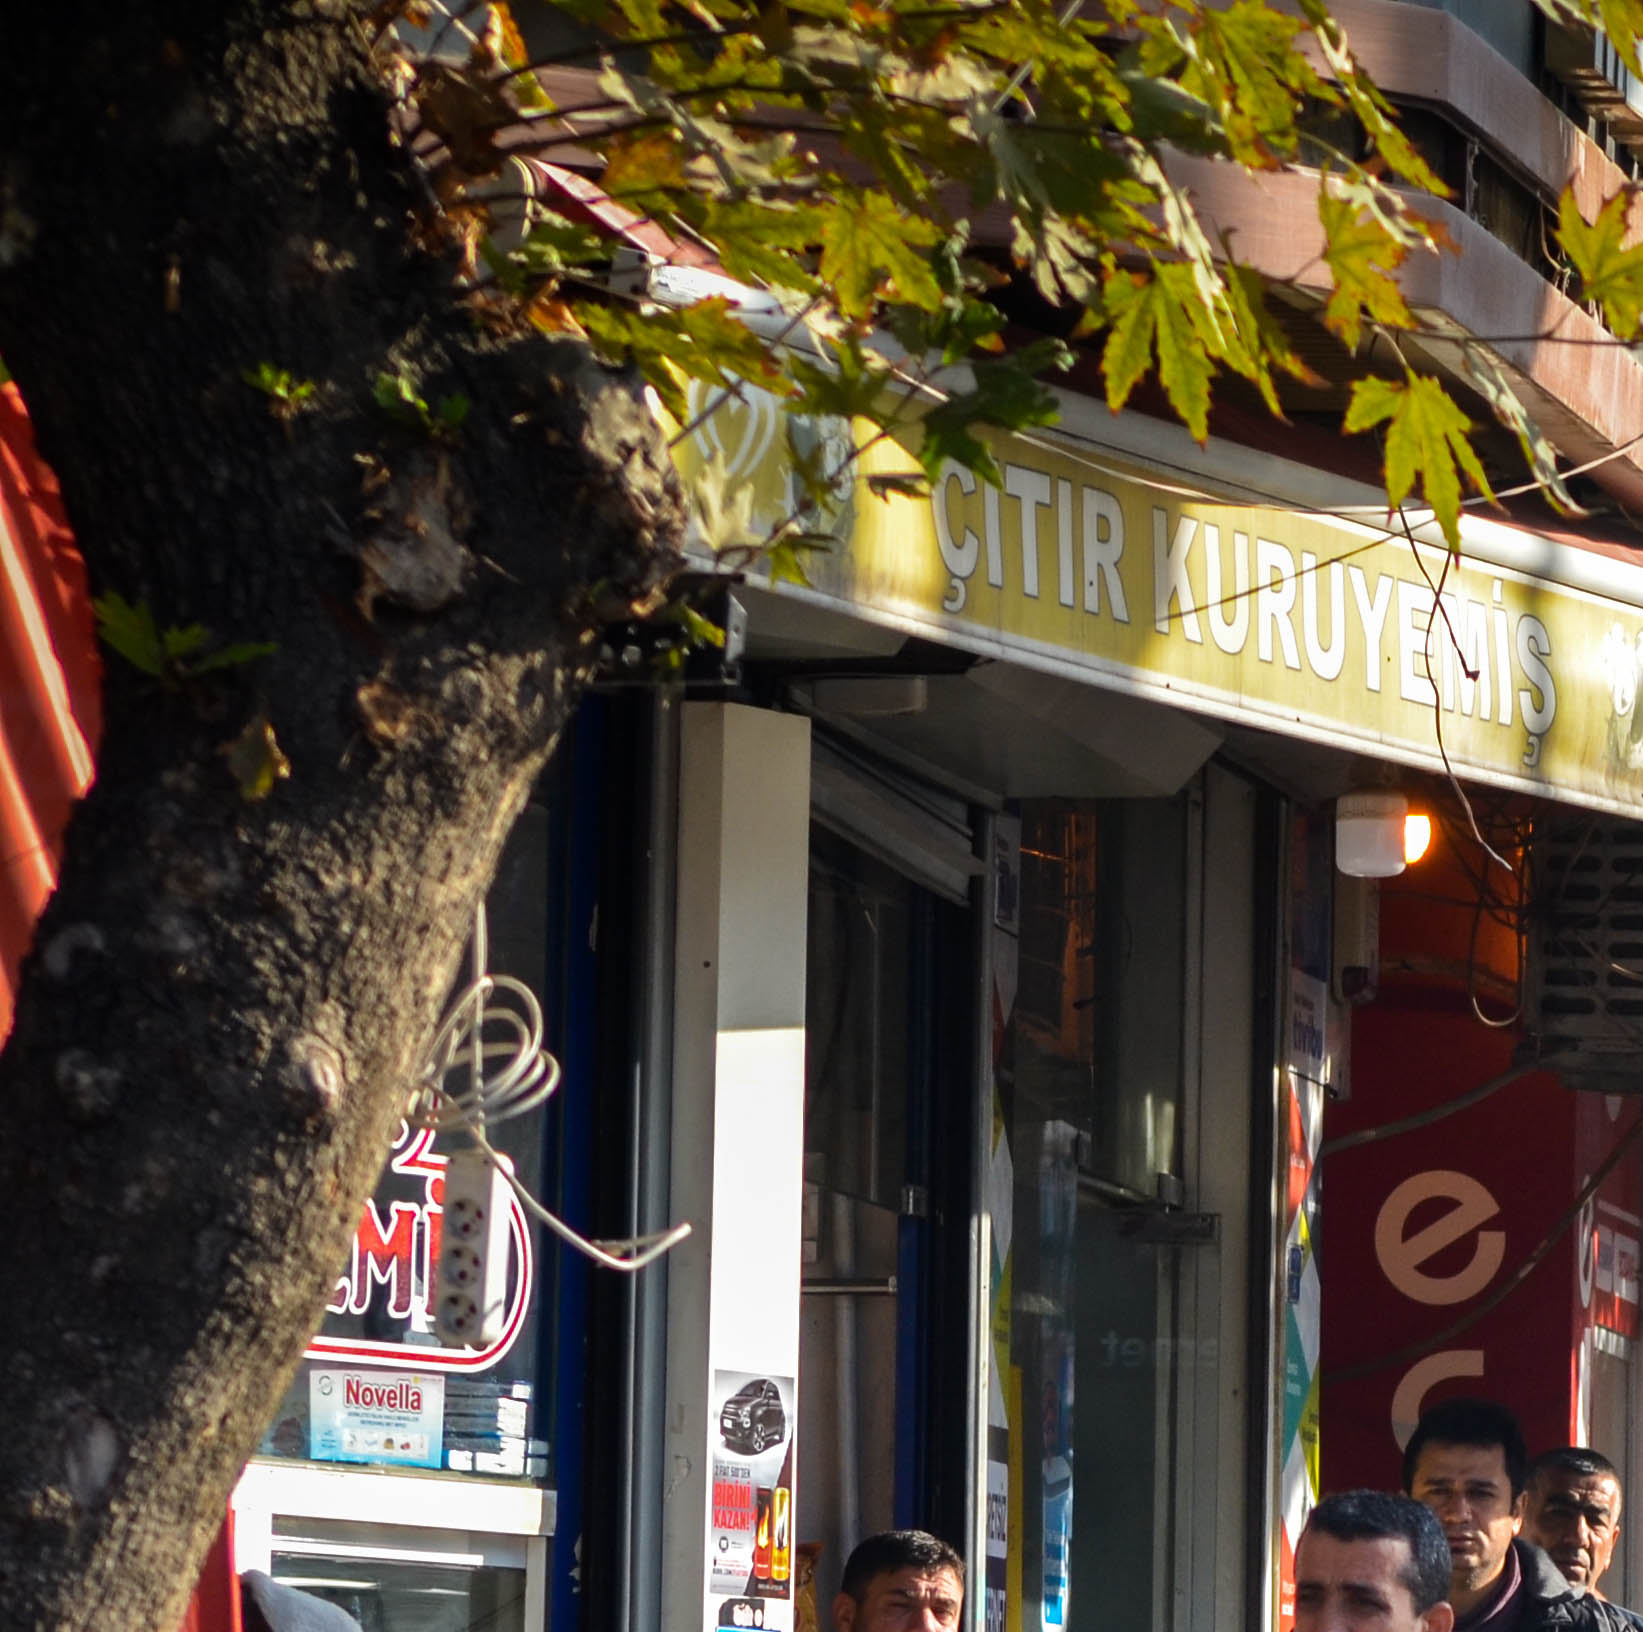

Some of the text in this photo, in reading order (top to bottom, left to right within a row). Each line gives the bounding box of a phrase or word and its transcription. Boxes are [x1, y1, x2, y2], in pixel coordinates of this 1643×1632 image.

[932, 464, 1557, 768] ÇITIR KURUYEMİŞ
[344, 1375, 423, 1412] Novella
[713, 1479, 751, 1509] BİRİNİ
[713, 1509, 751, 1532] KAZAN!
